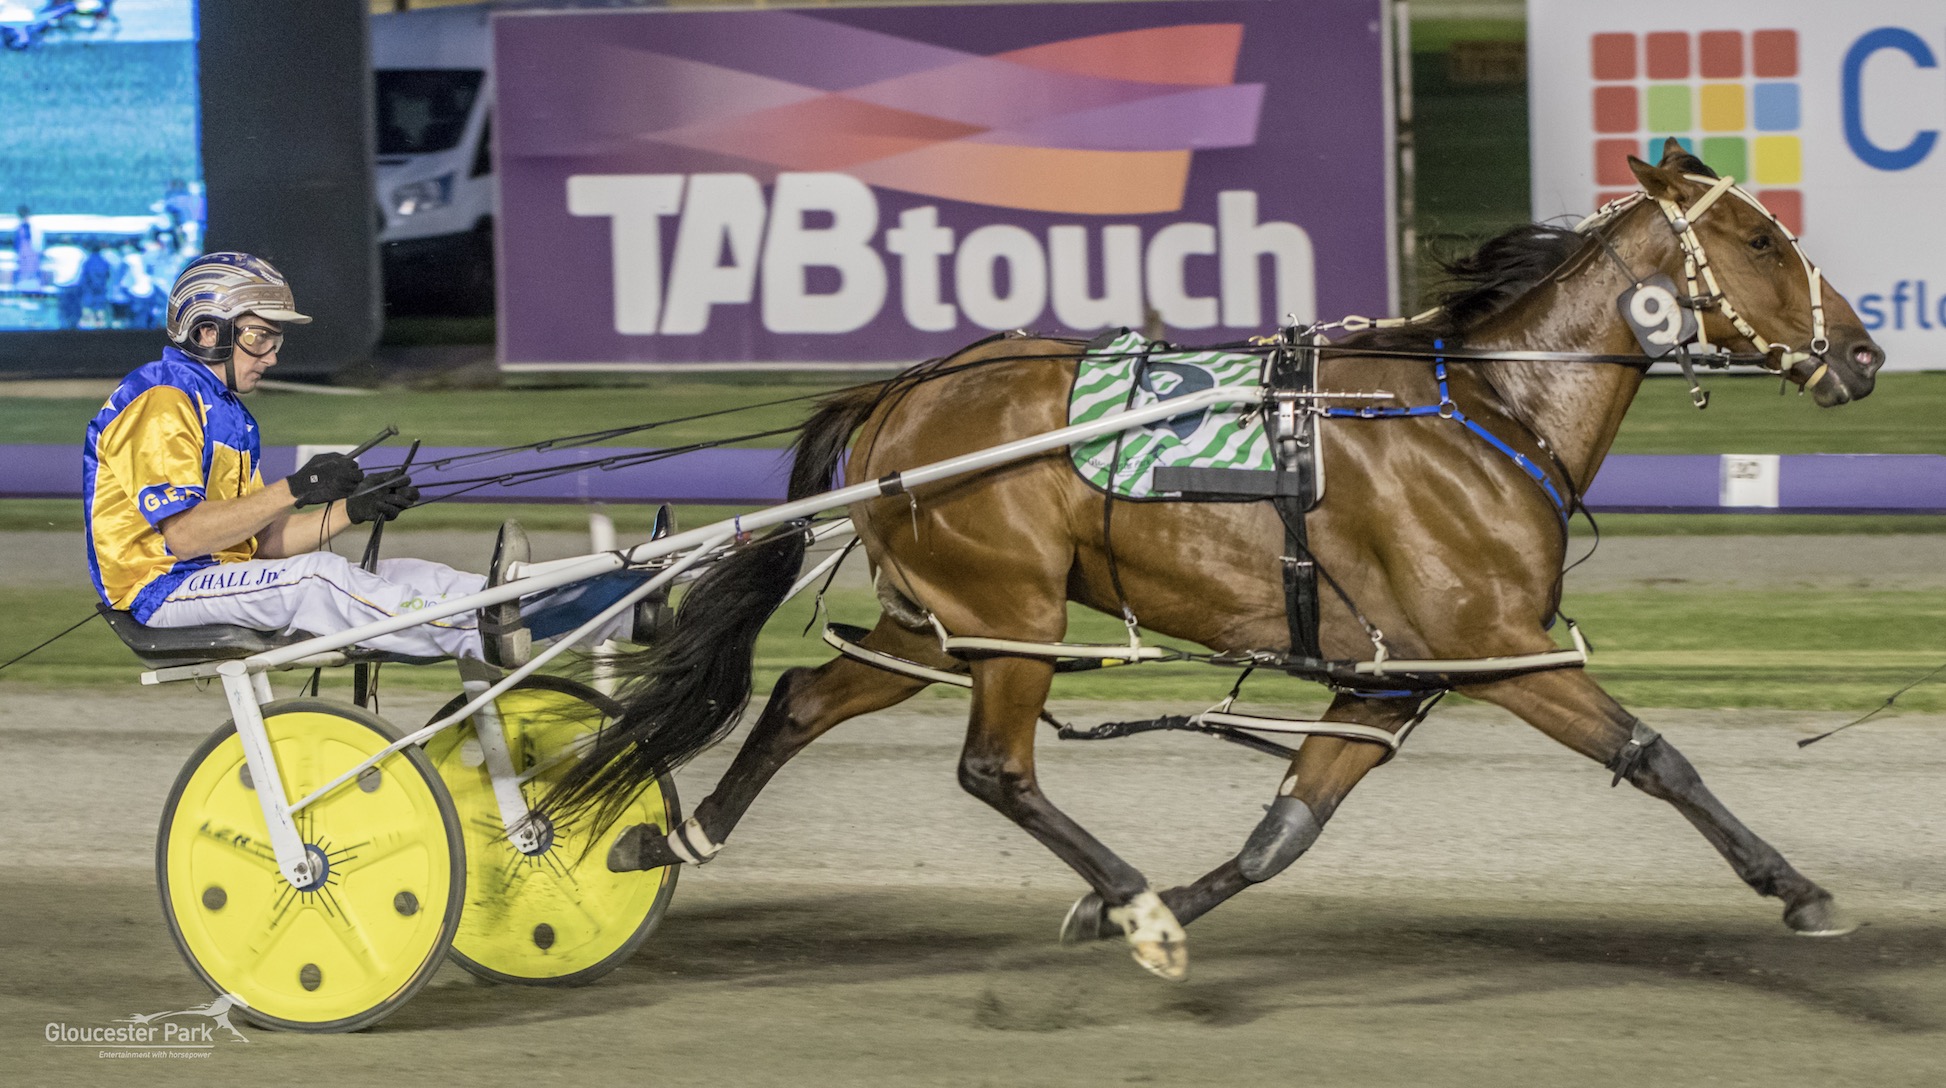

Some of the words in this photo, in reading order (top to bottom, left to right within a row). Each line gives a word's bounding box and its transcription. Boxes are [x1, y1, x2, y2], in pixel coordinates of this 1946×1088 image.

[1841, 26, 1946, 172] C
[566, 172, 1317, 335] TABtouch
[1858, 279, 1946, 330] sfl
[1630, 285, 1682, 345] 9
